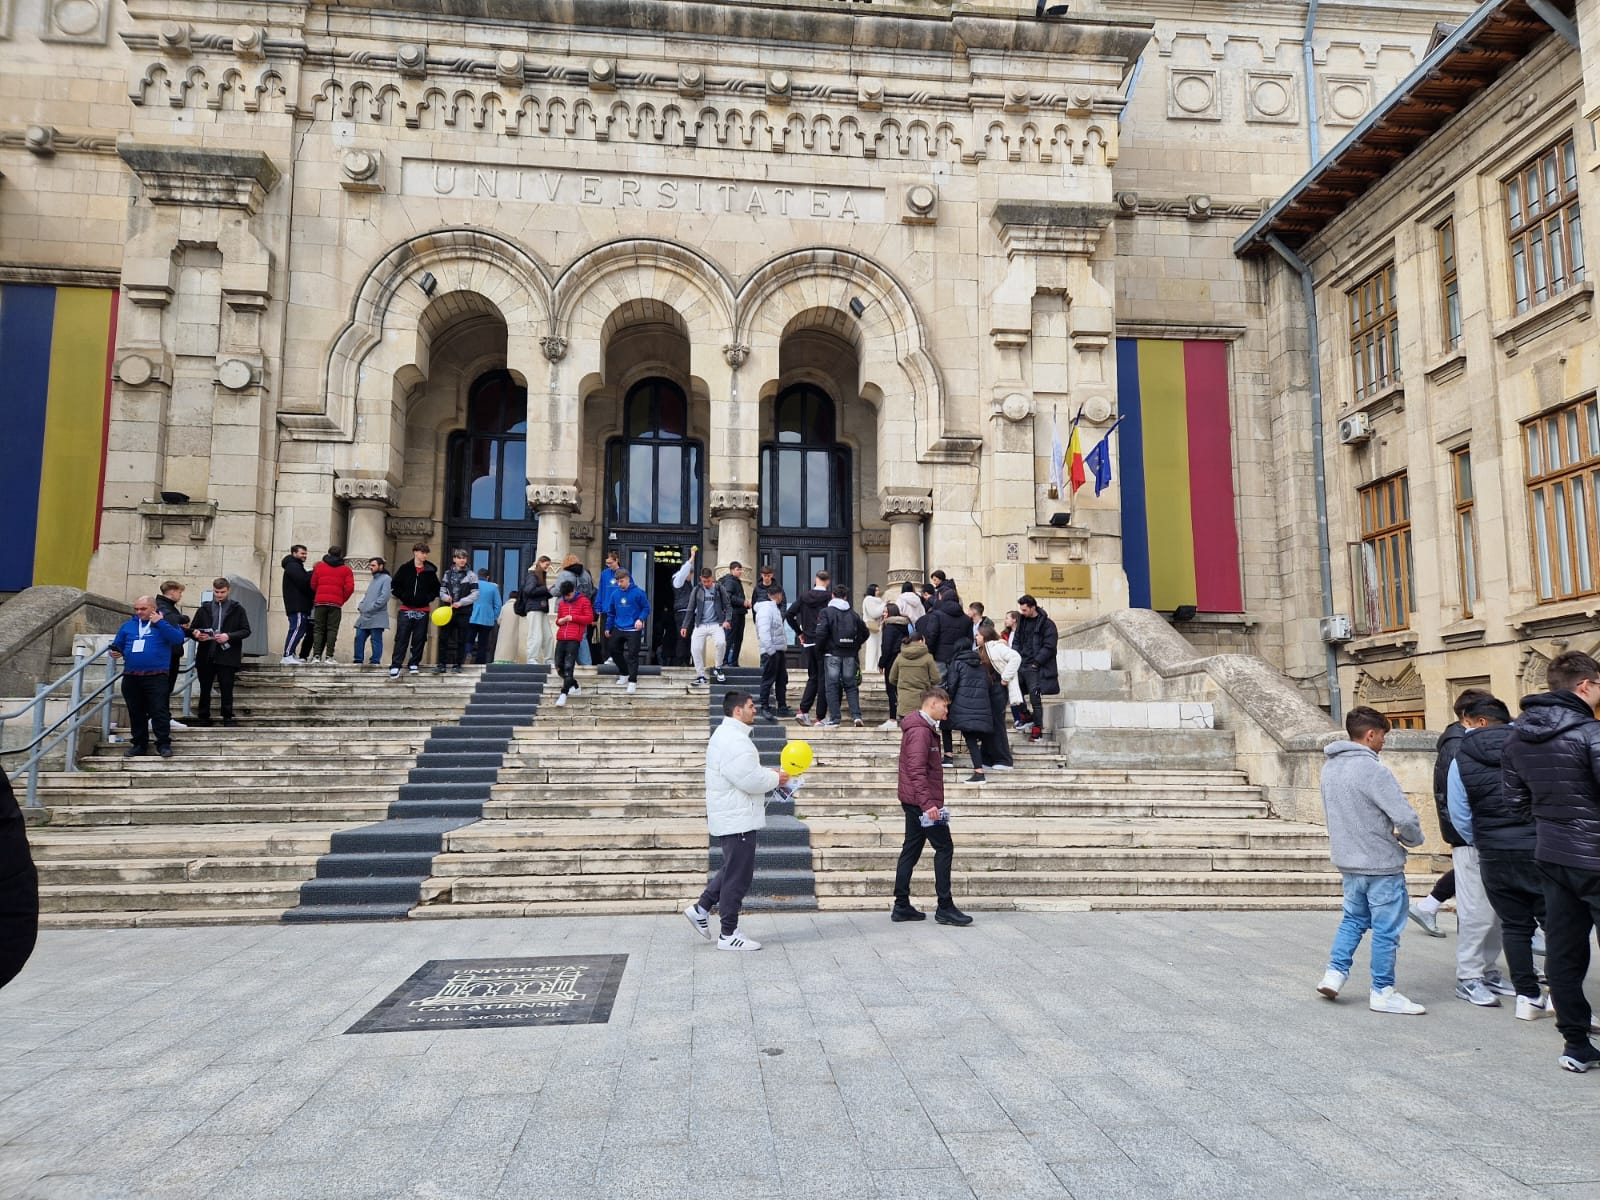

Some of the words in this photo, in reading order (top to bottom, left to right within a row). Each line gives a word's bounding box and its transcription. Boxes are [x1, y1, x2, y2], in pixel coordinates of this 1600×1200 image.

[431, 165, 860, 218] UNIVERSITATEA
[453, 965, 589, 975] UNIVERSITAS
[418, 1001, 570, 1012] GALATIENSIS
